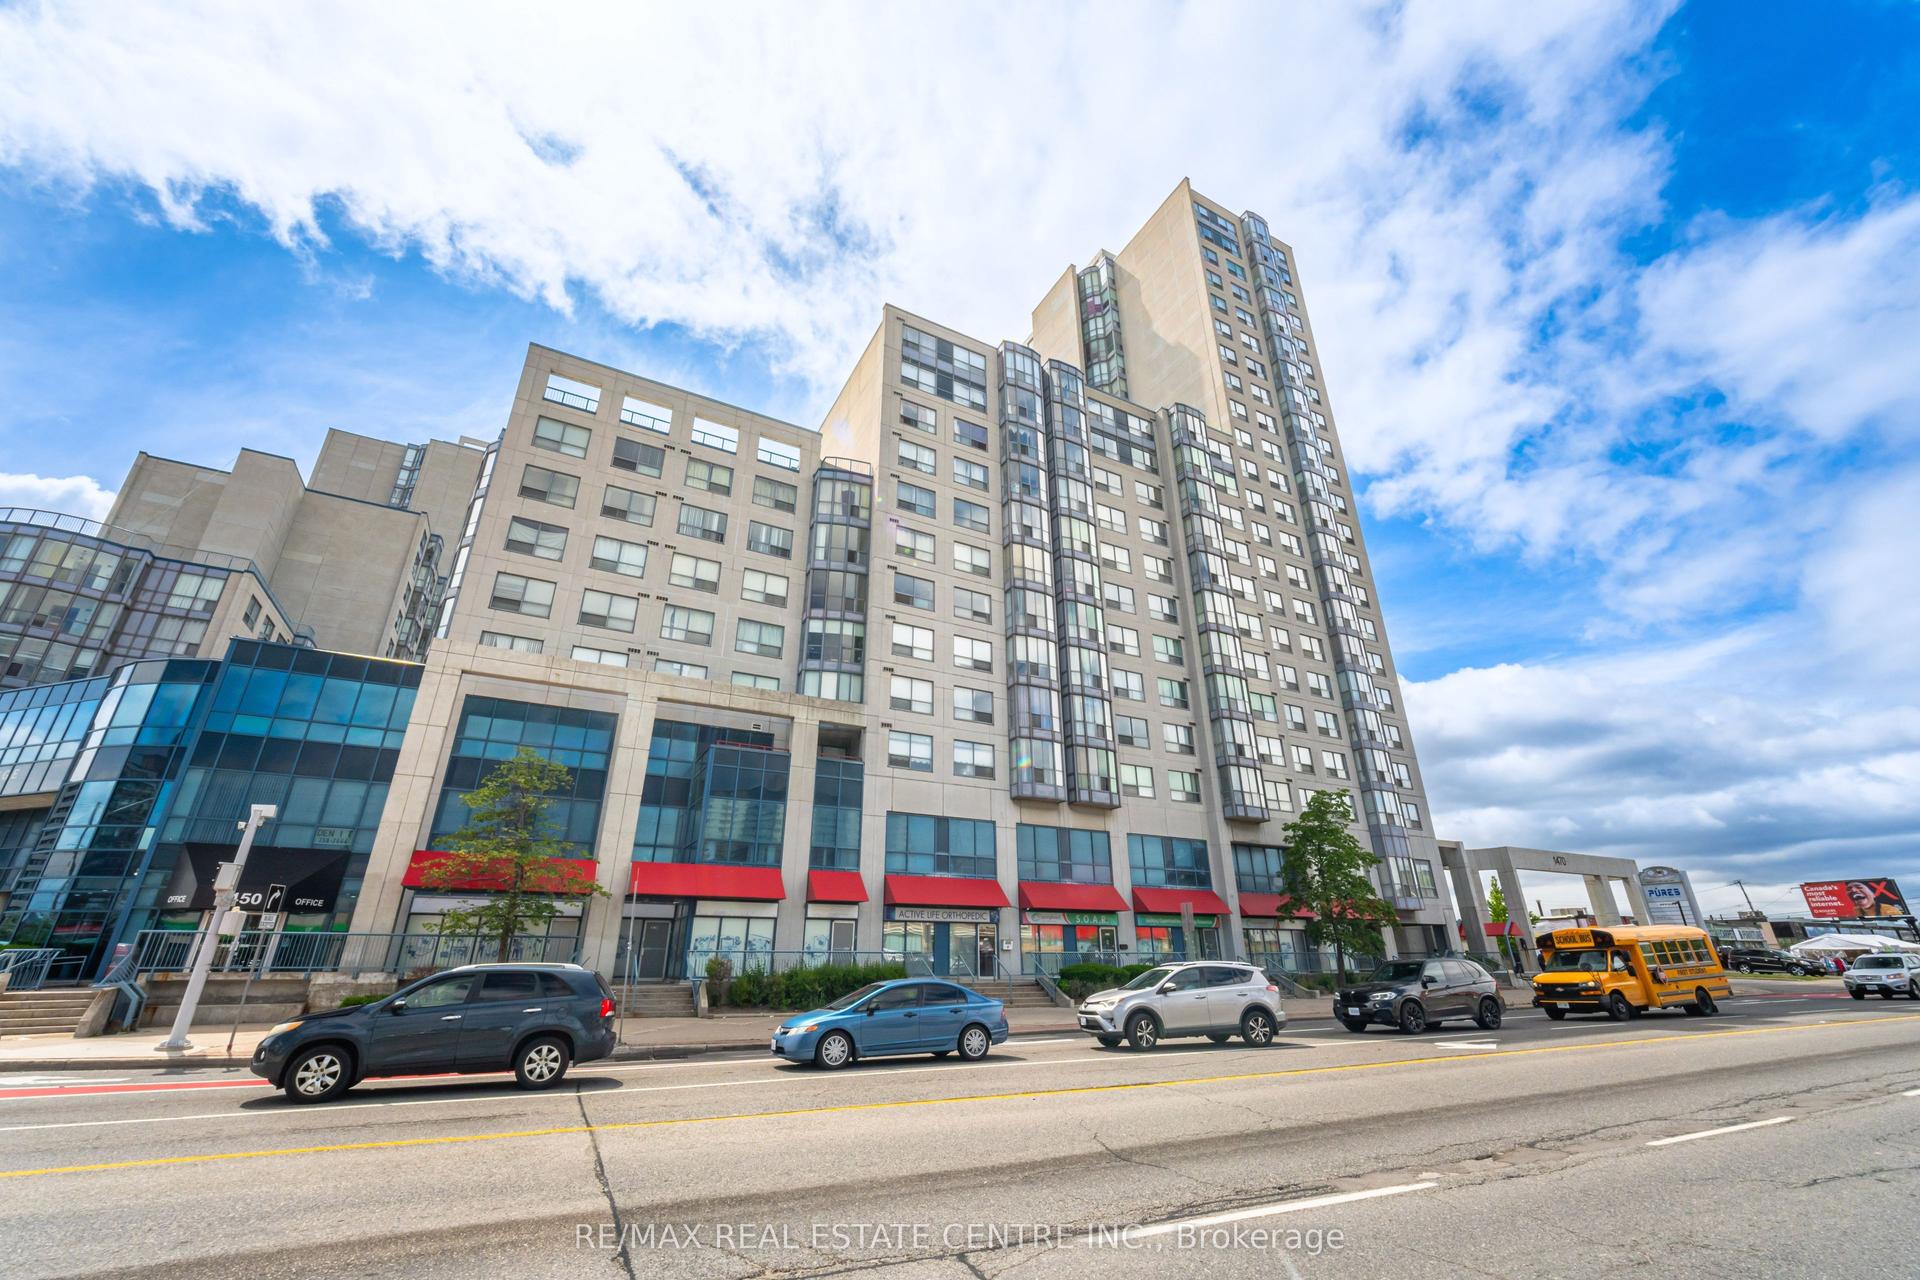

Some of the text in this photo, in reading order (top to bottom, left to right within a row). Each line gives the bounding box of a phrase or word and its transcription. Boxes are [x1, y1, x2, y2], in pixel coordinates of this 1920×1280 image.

[1552, 855, 1567, 866] 1470
[167, 895, 187, 904] OFFICE
[295, 898, 325, 907] OFFICE
[899, 910, 987, 920] ACTIVE LIFE ORTHOPEDIC
[1555, 934, 1592, 944] SCHOOL BUS
